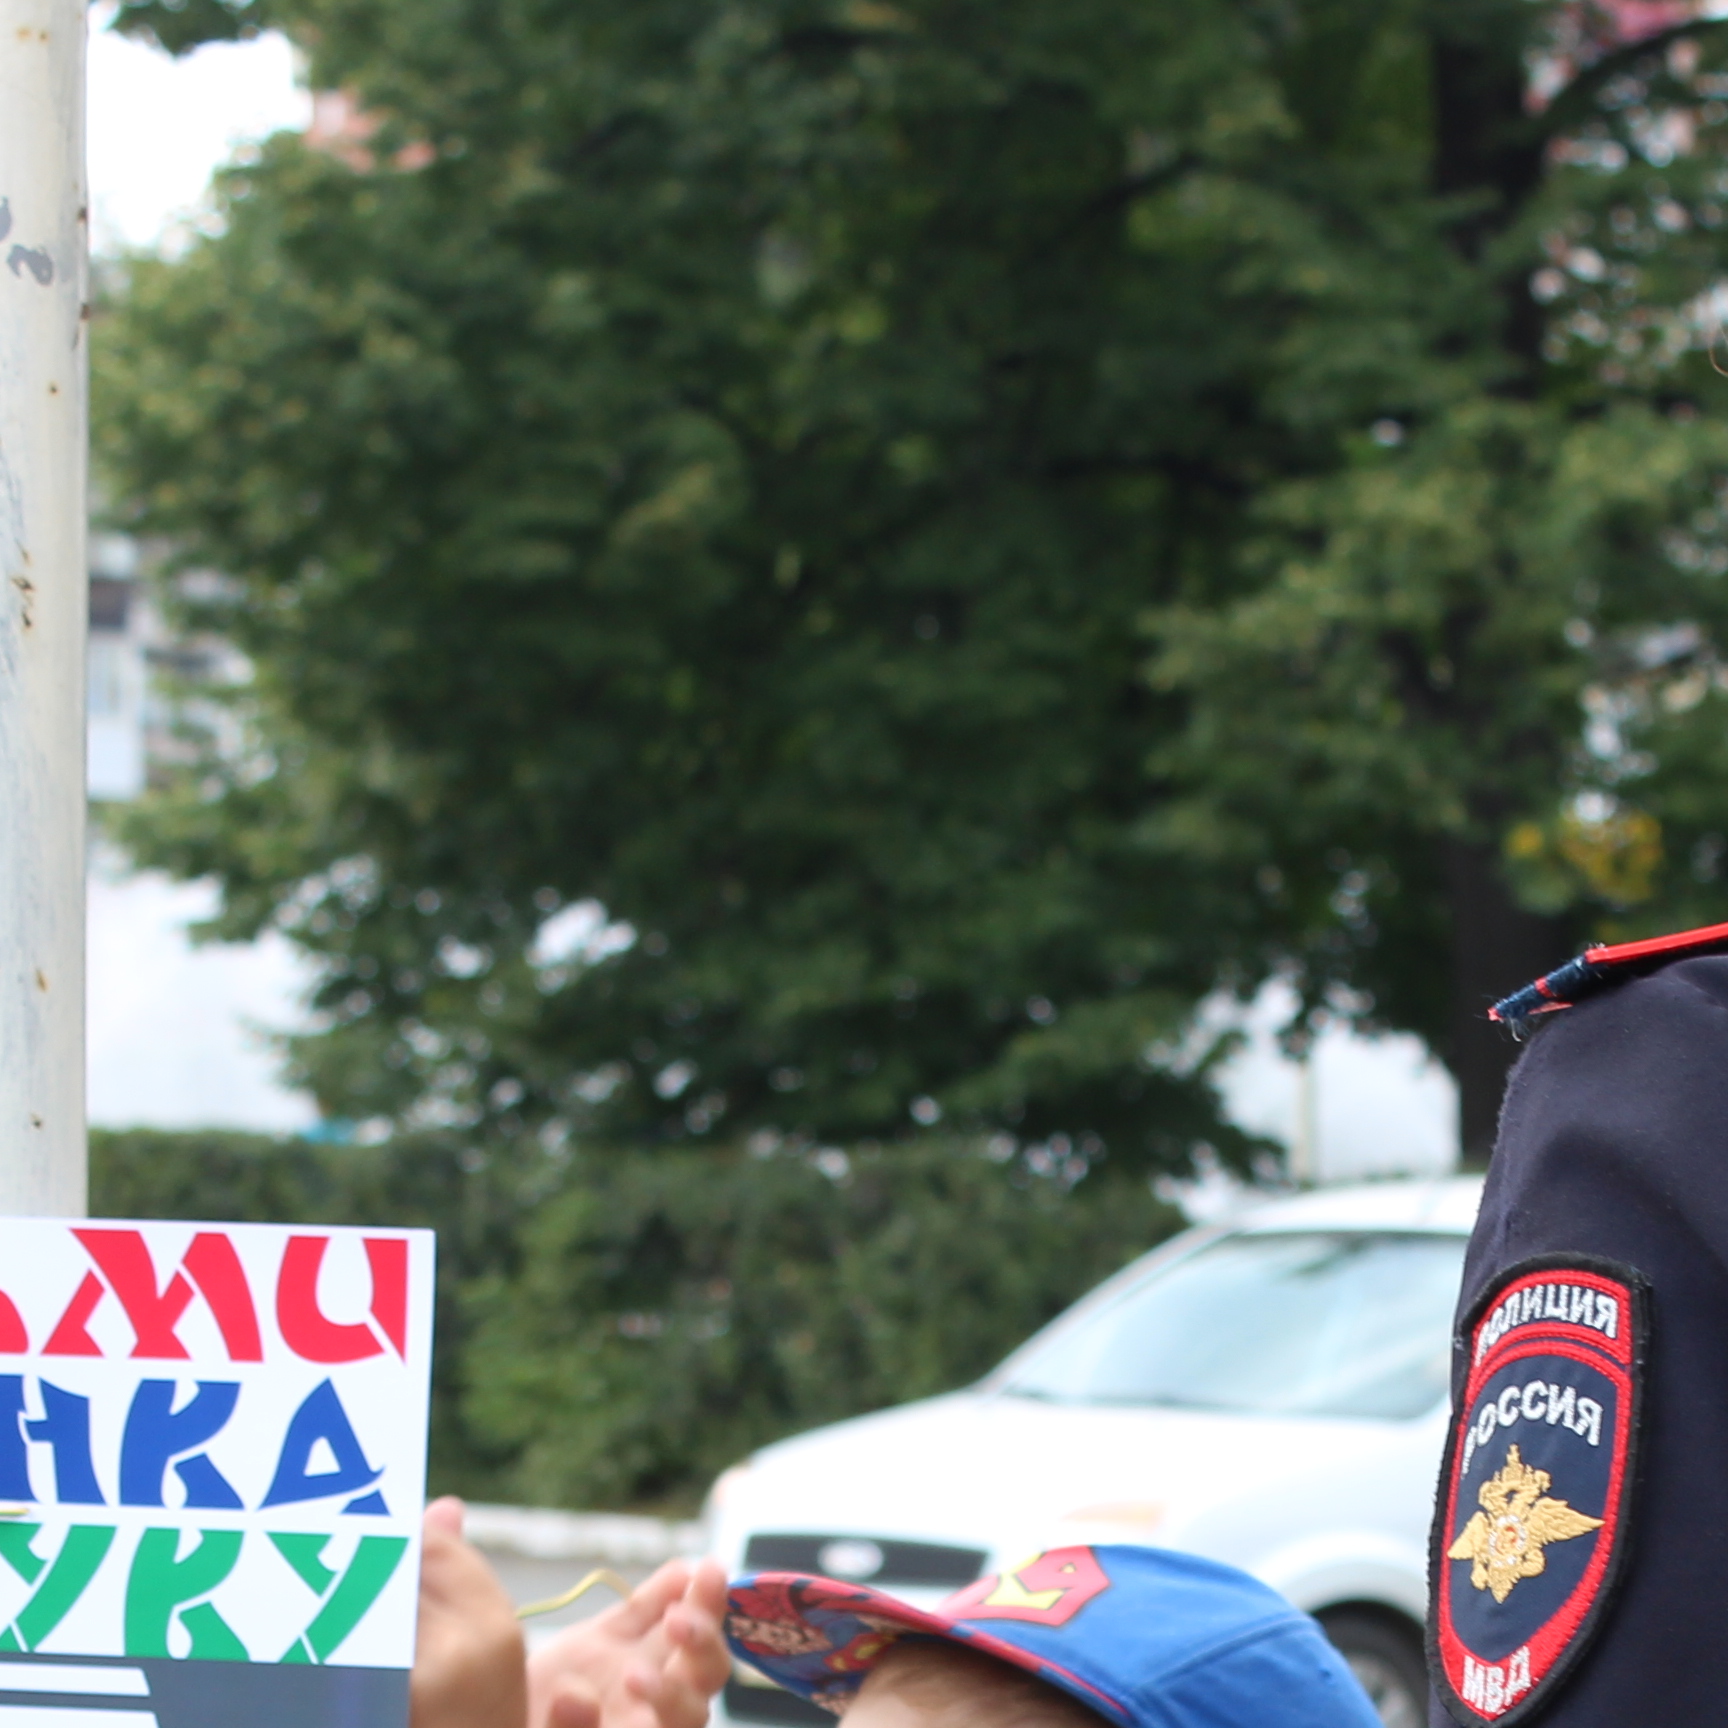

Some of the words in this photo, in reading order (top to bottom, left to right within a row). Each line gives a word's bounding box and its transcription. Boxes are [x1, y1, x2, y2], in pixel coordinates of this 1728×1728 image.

[1475, 1282, 1619, 1367] ПОЛИЦИЯ
[1462, 1380, 1603, 1480] РОССИЯ
[1461, 1645, 1532, 1713] МВД
